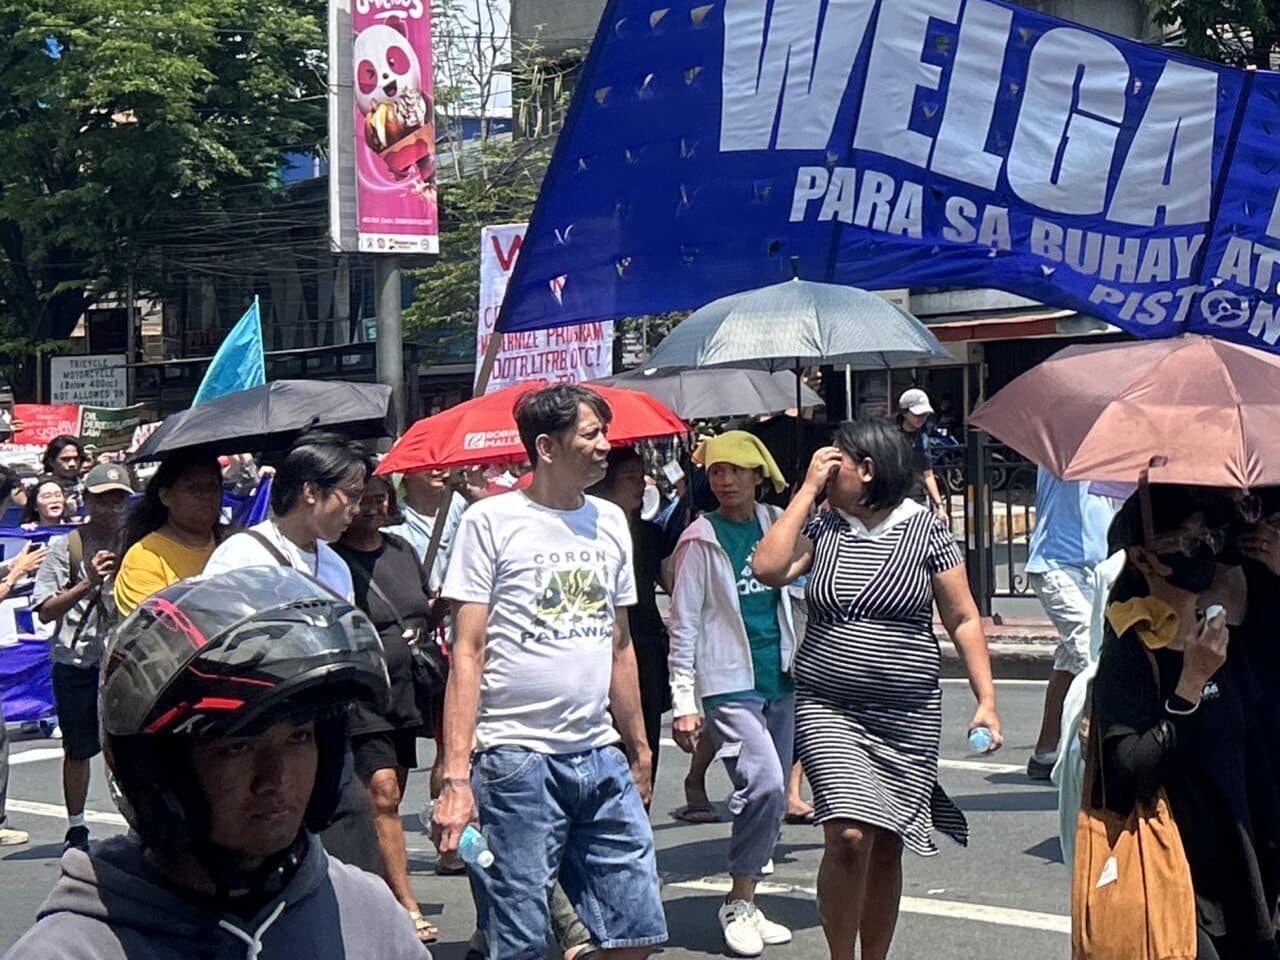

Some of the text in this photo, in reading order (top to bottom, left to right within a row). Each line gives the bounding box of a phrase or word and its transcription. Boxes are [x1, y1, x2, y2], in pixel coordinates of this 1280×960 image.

[788, 165, 924, 240] PARA
[942, 195, 1012, 251] SA
[1030, 216, 1206, 284] BUHAY
[69, 358, 108, 368] TRICYCLE
[63, 368, 115, 379] MOTORCYCLE
[54, 391, 69, 400] NOT
[72, 389, 111, 400] ALLOWED
[533, 550, 607, 565] CORON
